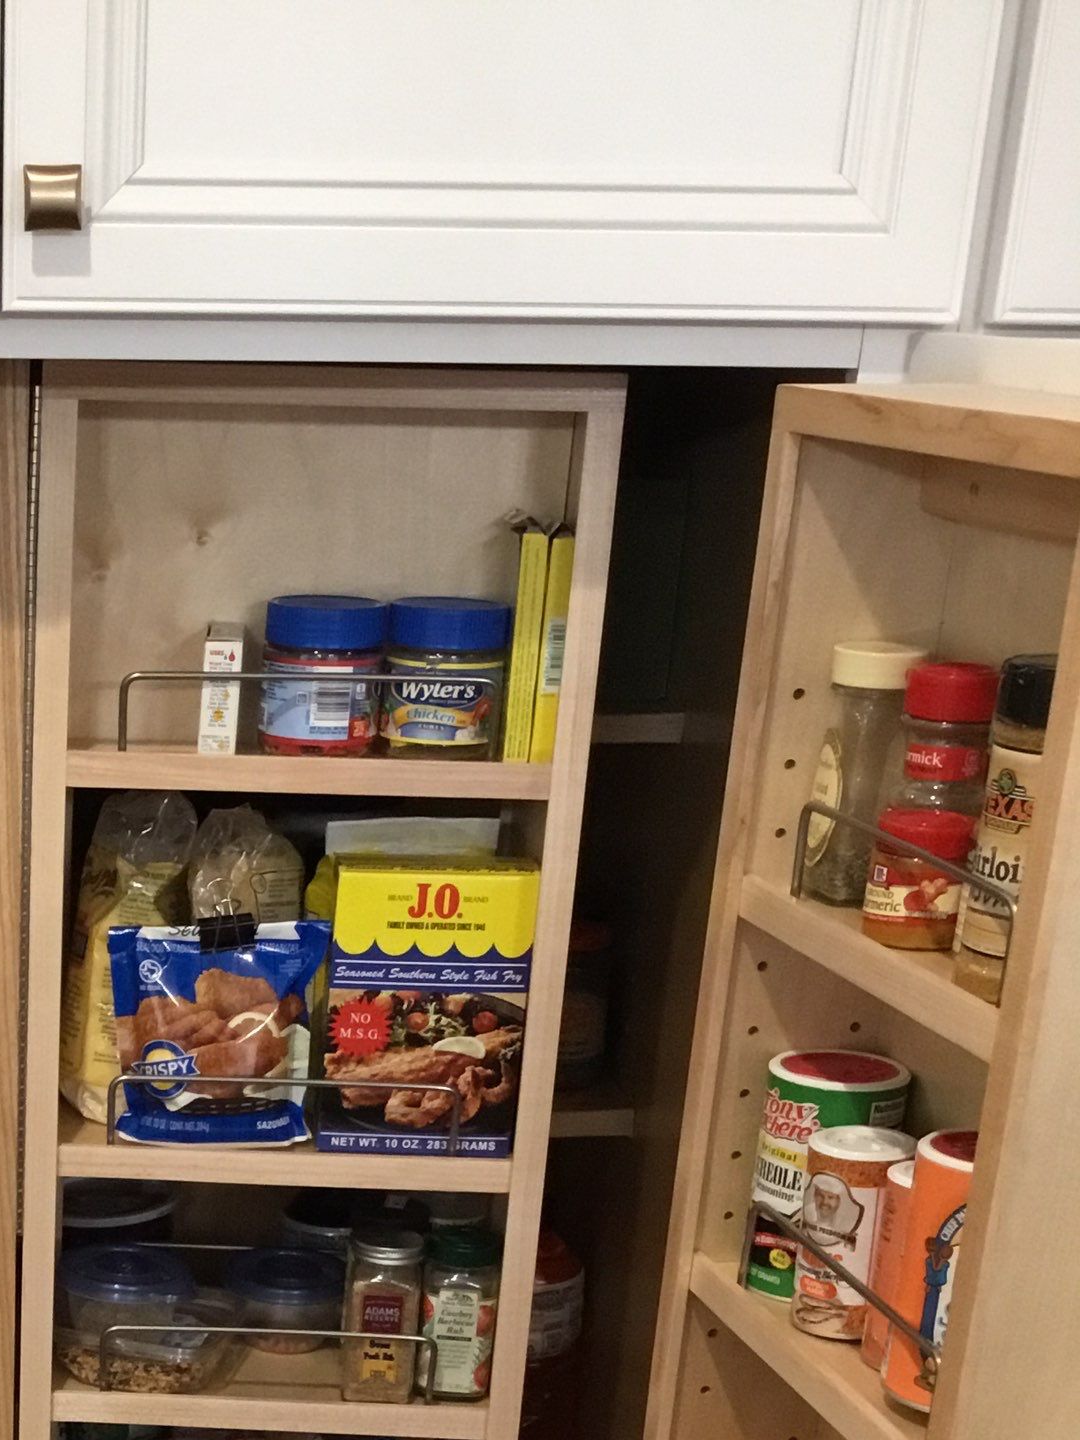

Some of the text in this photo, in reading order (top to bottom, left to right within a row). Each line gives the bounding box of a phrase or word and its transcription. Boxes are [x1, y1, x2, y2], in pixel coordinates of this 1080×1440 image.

[401, 682, 476, 701] Wyler's
[406, 707, 456, 724] Chicken
[985, 795, 1035, 821] EXAS
[975, 846, 1021, 885] irloi
[334, 966, 523, 984] Seasoned Southern Style Fish Fry
[350, 1012, 371, 1024] NO
[139, 1059, 189, 1076] CRISPY
[331, 1137, 355, 1147] NET
[385, 1139, 398, 1149] 10
[426, 1140, 448, 1150] 283
[365, 1306, 400, 1316] ADAMS
